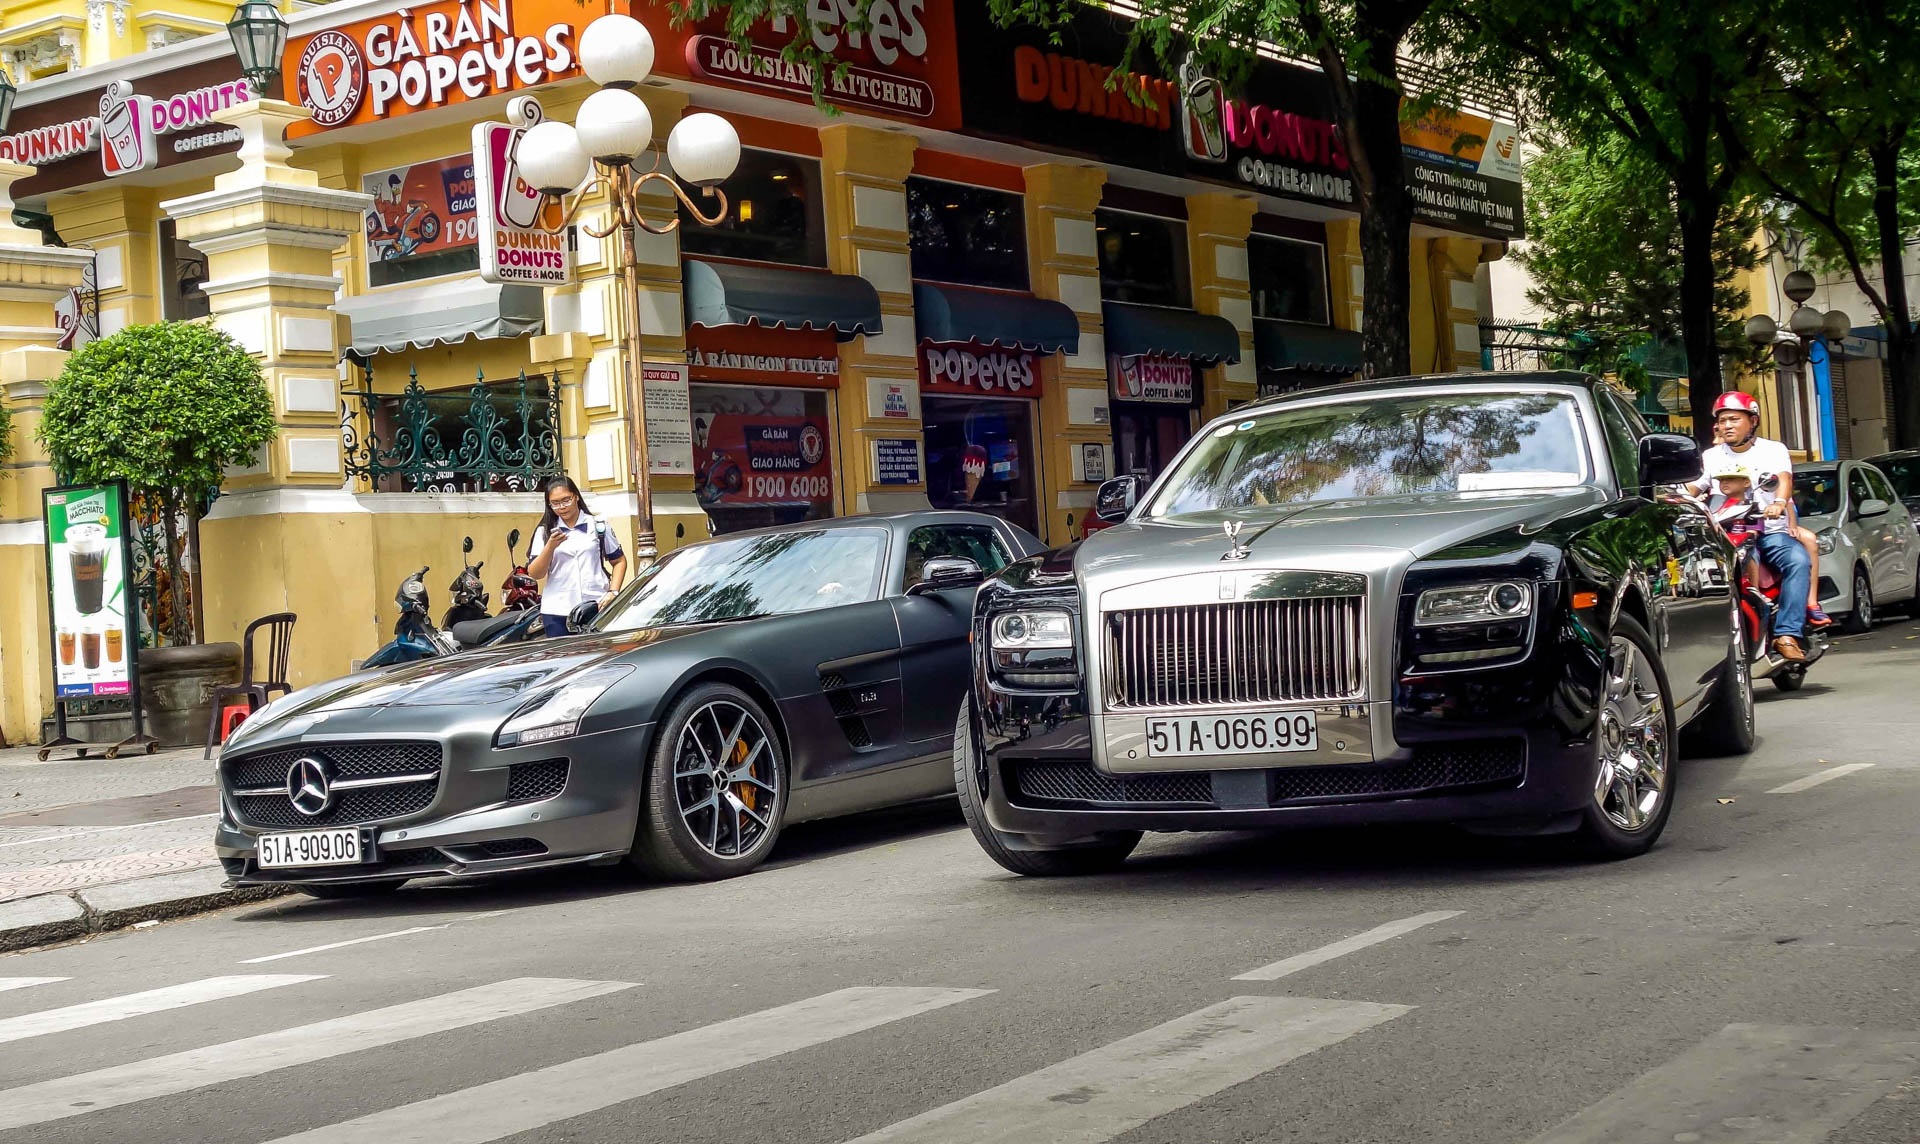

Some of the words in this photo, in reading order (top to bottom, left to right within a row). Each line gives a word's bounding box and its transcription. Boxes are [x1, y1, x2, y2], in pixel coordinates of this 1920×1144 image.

[366, 9, 420, 66] GÀ
[300, 34, 358, 77] LOUISIANA
[833, 70, 922, 108] KITCHEN
[152, 82, 249, 131] DONUTS
[304, 87, 358, 122] KITCHEN
[0, 120, 93, 163] DUNKIN'
[1415, 166, 1434, 182] CÔNG
[1434, 172, 1443, 184] TY
[1462, 178, 1477, 192] DỊCH
[1477, 181, 1487, 197] VỤ
[451, 196, 476, 212] GIAO
[1436, 192, 1443, 206] &
[1460, 196, 1478, 213] KHÁT
[1479, 200, 1495, 219] VIỆT
[1496, 204, 1514, 220] NAM
[496, 231, 565, 251] DUNKIN'
[498, 249, 563, 268] DONUTS
[500, 268, 532, 279] COFFEE
[540, 270, 564, 280] MORE
[684, 347, 705, 366] GÀ
[706, 349, 741, 369] RÁN
[741, 354, 786, 372] NGON
[1144, 365, 1191, 385] DONUTS
[1145, 387, 1168, 398] COFFEE
[1174, 388, 1191, 399] MORE
[762, 427, 773, 439] GÀ
[752, 457, 773, 469] GIAO
[775, 455, 800, 469] HÀNG
[747, 476, 786, 498] 1900
[790, 476, 829, 498] 6008
[70, 505, 104, 520] MACCHIATO
[1152, 715, 1311, 753] 51A-066.99
[262, 832, 356, 865] 51A-909.06
